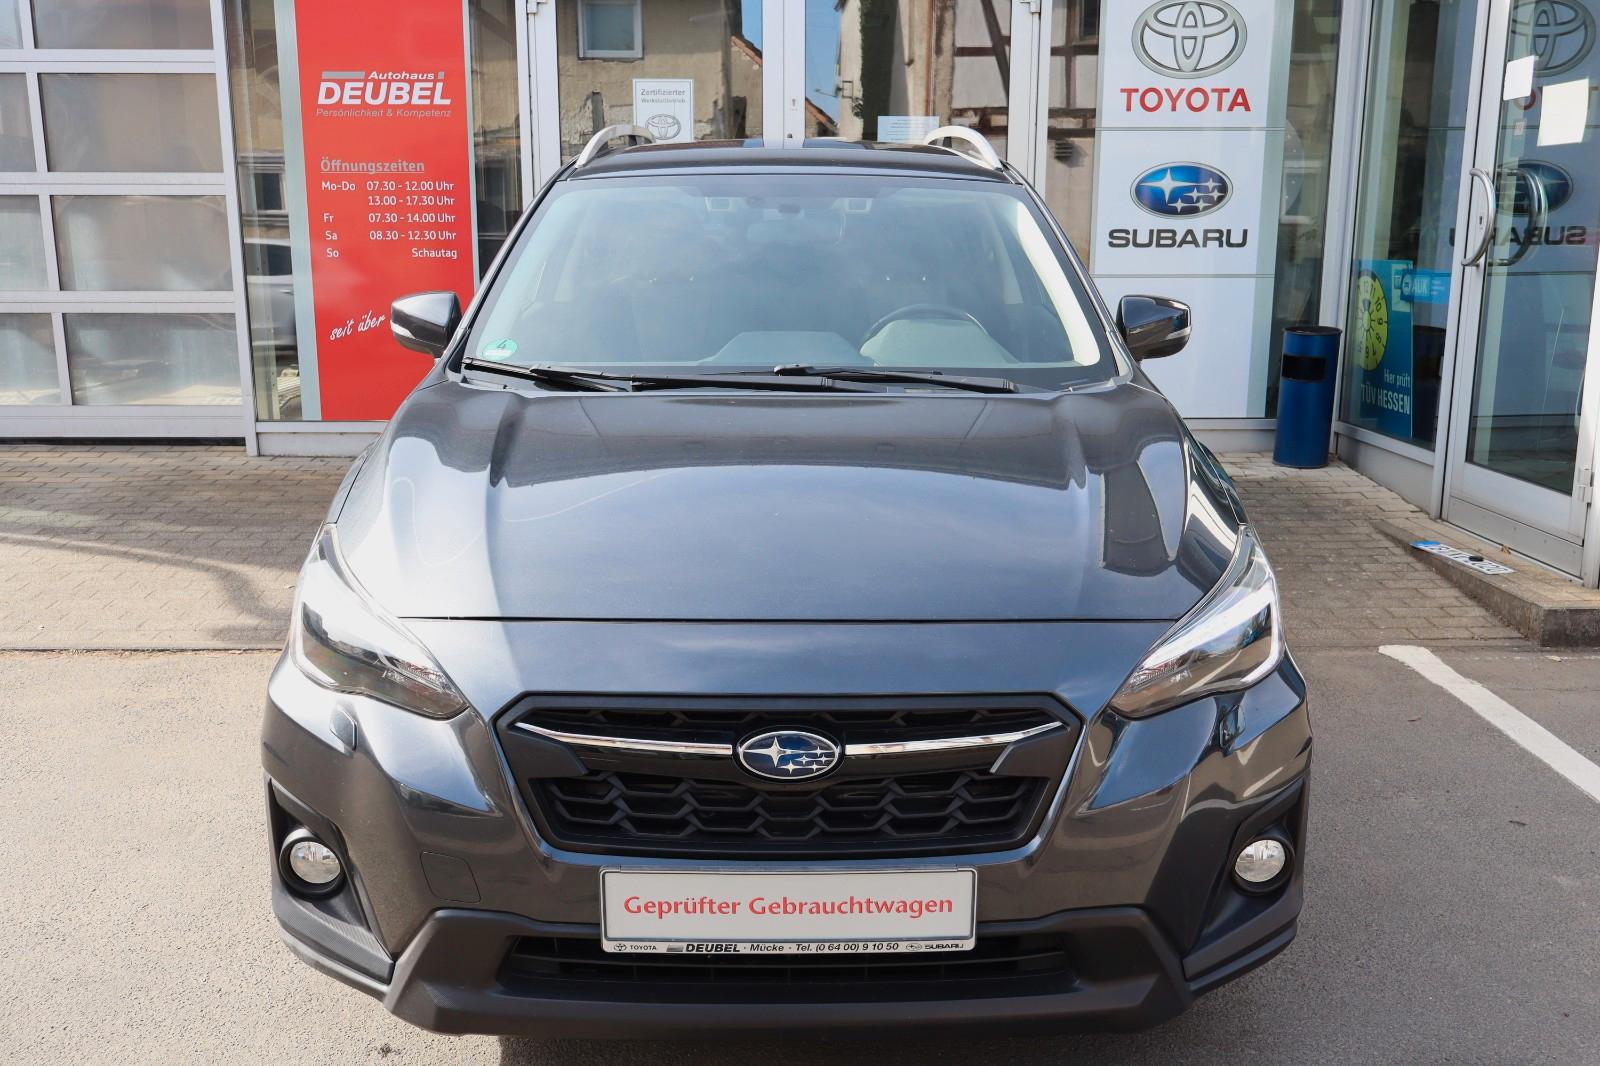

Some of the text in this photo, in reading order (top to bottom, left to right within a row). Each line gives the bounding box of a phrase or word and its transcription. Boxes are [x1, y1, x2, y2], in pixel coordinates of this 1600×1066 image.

[368, 71, 434, 80] Autohaus
[317, 82, 451, 105] DEUBEL
[1120, 87, 1251, 112] TOYOTA
[316, 108, 452, 119] Persönlichkeit & Kompetenz
[320, 157, 425, 174] Öffnungszeiten
[321, 181, 356, 191] Mo-Do
[366, 181, 396, 191] 07.30
[405, 181, 434, 191] 12.00
[436, 181, 455, 191] Uhr
[368, 196, 397, 206] 13.00
[406, 196, 435, 206] 17.30
[437, 196, 455, 206] Uhr
[323, 213, 334, 223] Fr
[368, 213, 398, 223] 07.30
[407, 213, 436, 223] 14.00
[437, 213, 456, 223] Uhr
[325, 231, 338, 240] Sa
[369, 231, 399, 240] 08.30
[408, 231, 437, 240] 12.30
[438, 231, 457, 240] Uhr
[1108, 228, 1249, 248] SUBARU
[326, 248, 458, 260] So Schautag
[1374, 297, 1382, 312] 10
[329, 310, 386, 341] seit über
[1383, 368, 1411, 388] Hier prüft
[1360, 381, 1410, 415] TÜV HESSEN
[623, 895, 953, 919] Geprüfter Gebrauchtwagen
[685, 943, 741, 953] DEUBEL
[750, 943, 785, 952] Mücke
[795, 943, 813, 952] Tel.
[815, 943, 826, 952] (0
[827, 943, 840, 951] 64
[843, 943, 860, 952] 00)
[862, 943, 869, 951] 9
[872, 943, 884, 951] 10
[885, 943, 899, 951] 50
